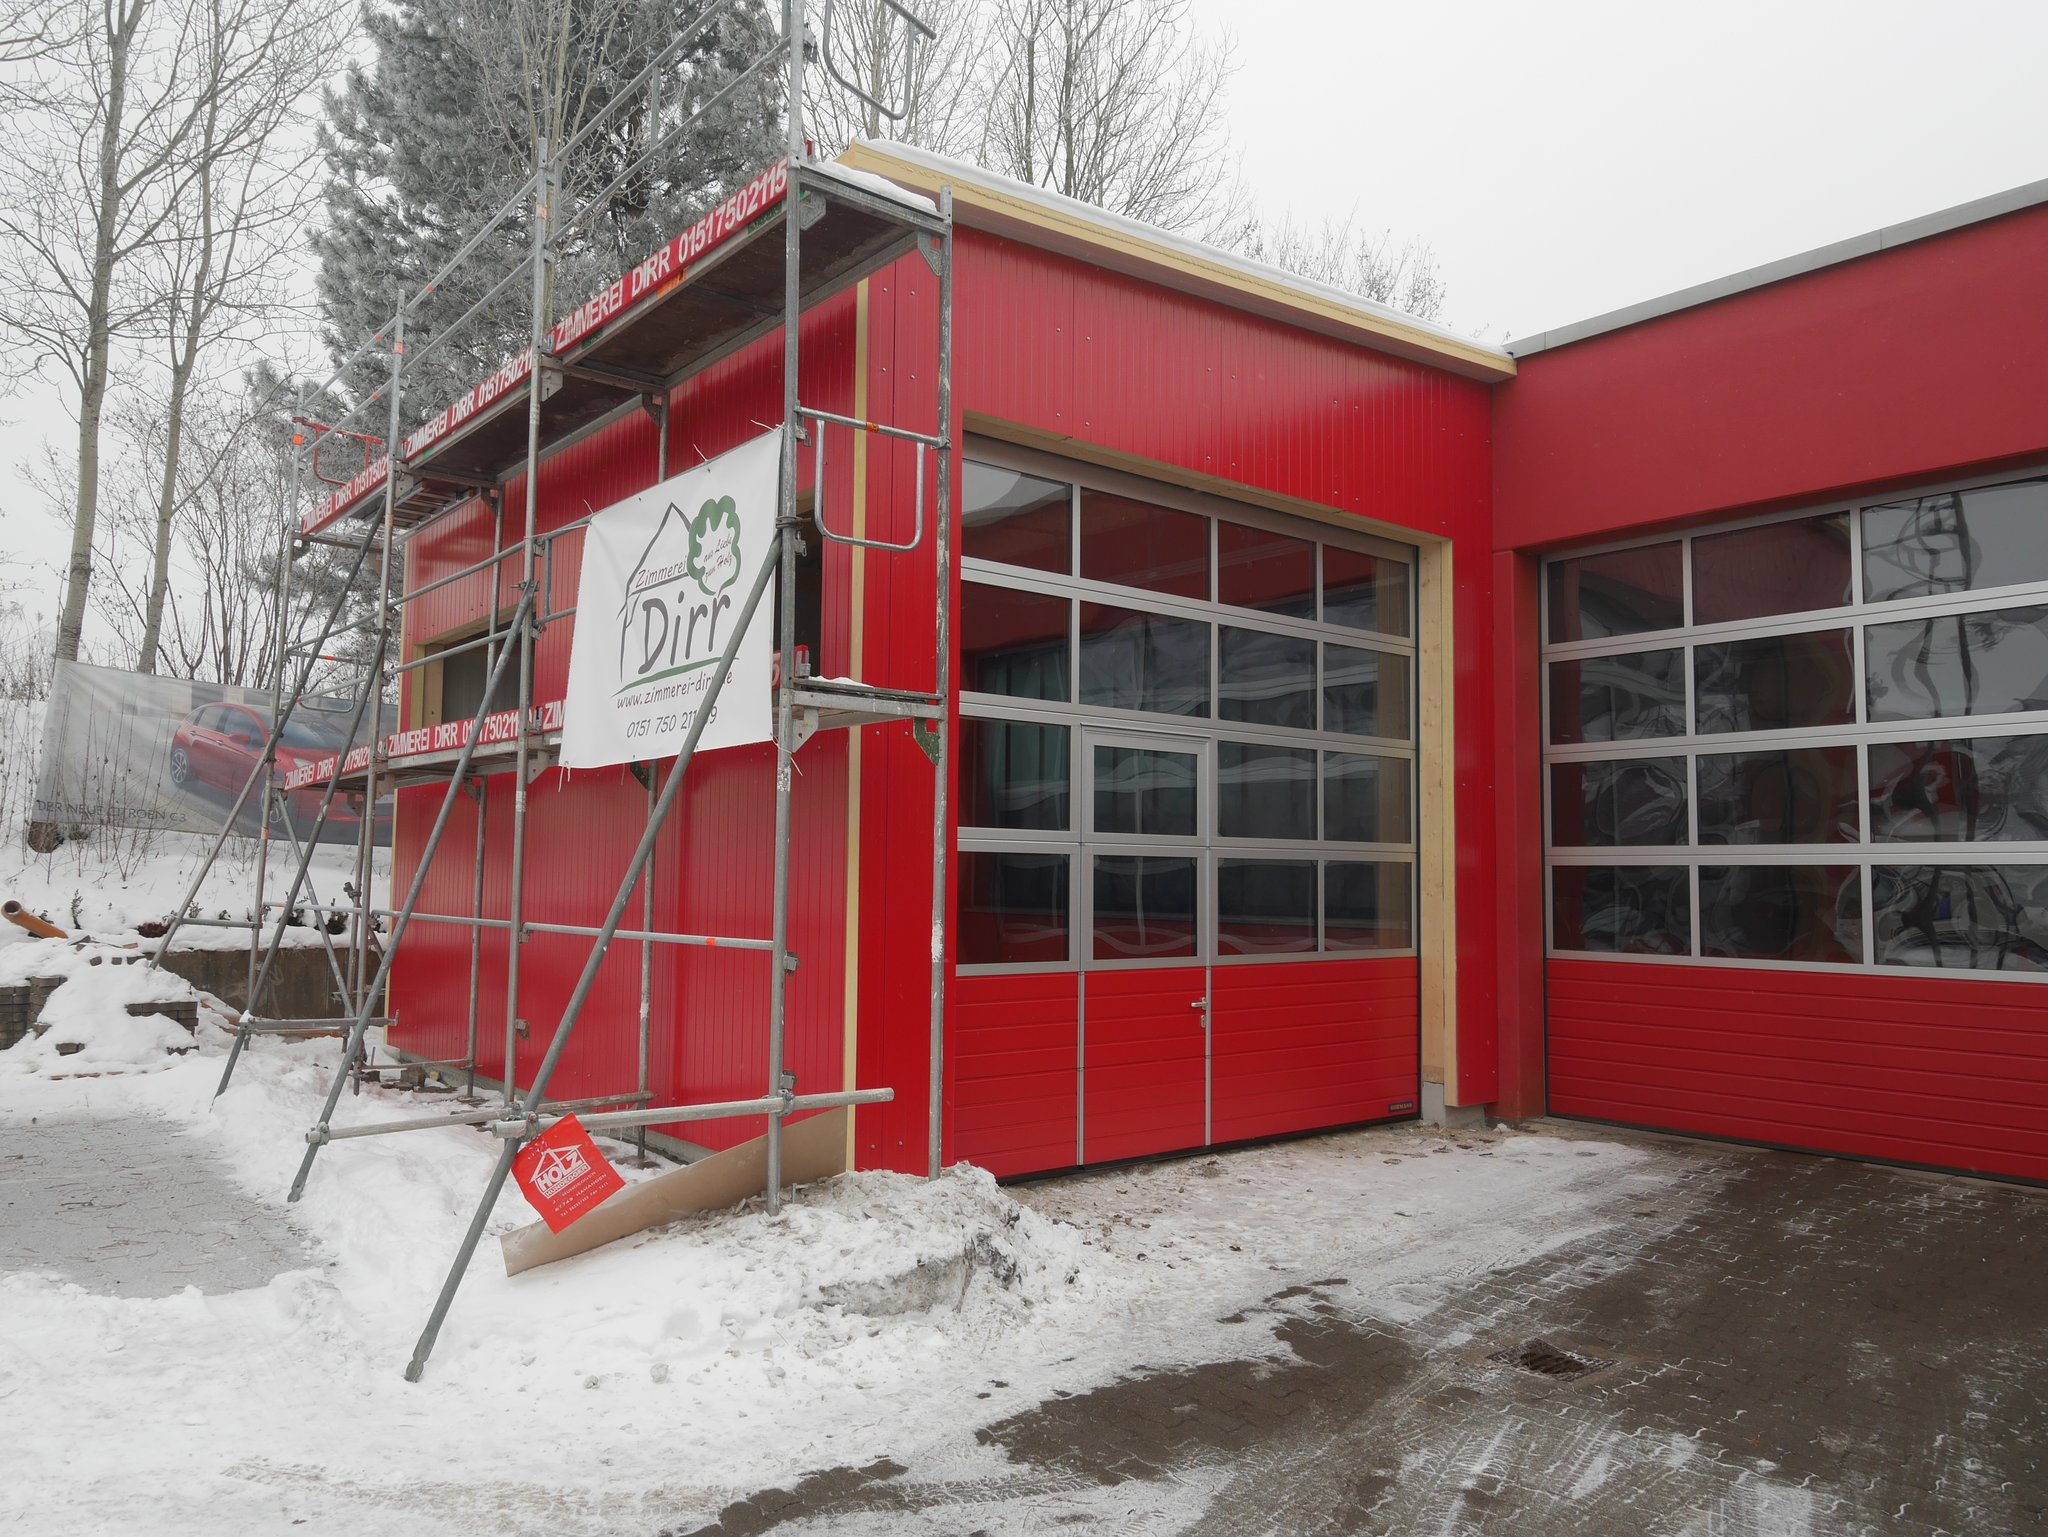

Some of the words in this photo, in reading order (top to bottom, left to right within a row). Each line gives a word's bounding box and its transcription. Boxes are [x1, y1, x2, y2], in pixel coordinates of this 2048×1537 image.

[555, 279, 624, 351] ZIMMEREI
[631, 245, 671, 298] DIRR
[678, 157, 787, 264] 01517502115
[405, 411, 448, 459] ZIMMEREI
[451, 390, 475, 427] DIRR
[478, 349, 533, 408] 0151750211
[635, 555, 688, 588] Zimmerei
[638, 590, 731, 675] Dirr
[388, 728, 430, 756] ZIMMEREI
[434, 724, 458, 748] DIRR
[626, 718, 651, 738] 0151
[655, 714, 677, 734] 750
[680, 705, 718, 730] 2119
[285, 763, 315, 790] ZIMMEREI
[317, 757, 334, 780] DIRR
[537, 1150, 584, 1192] HOLZ
